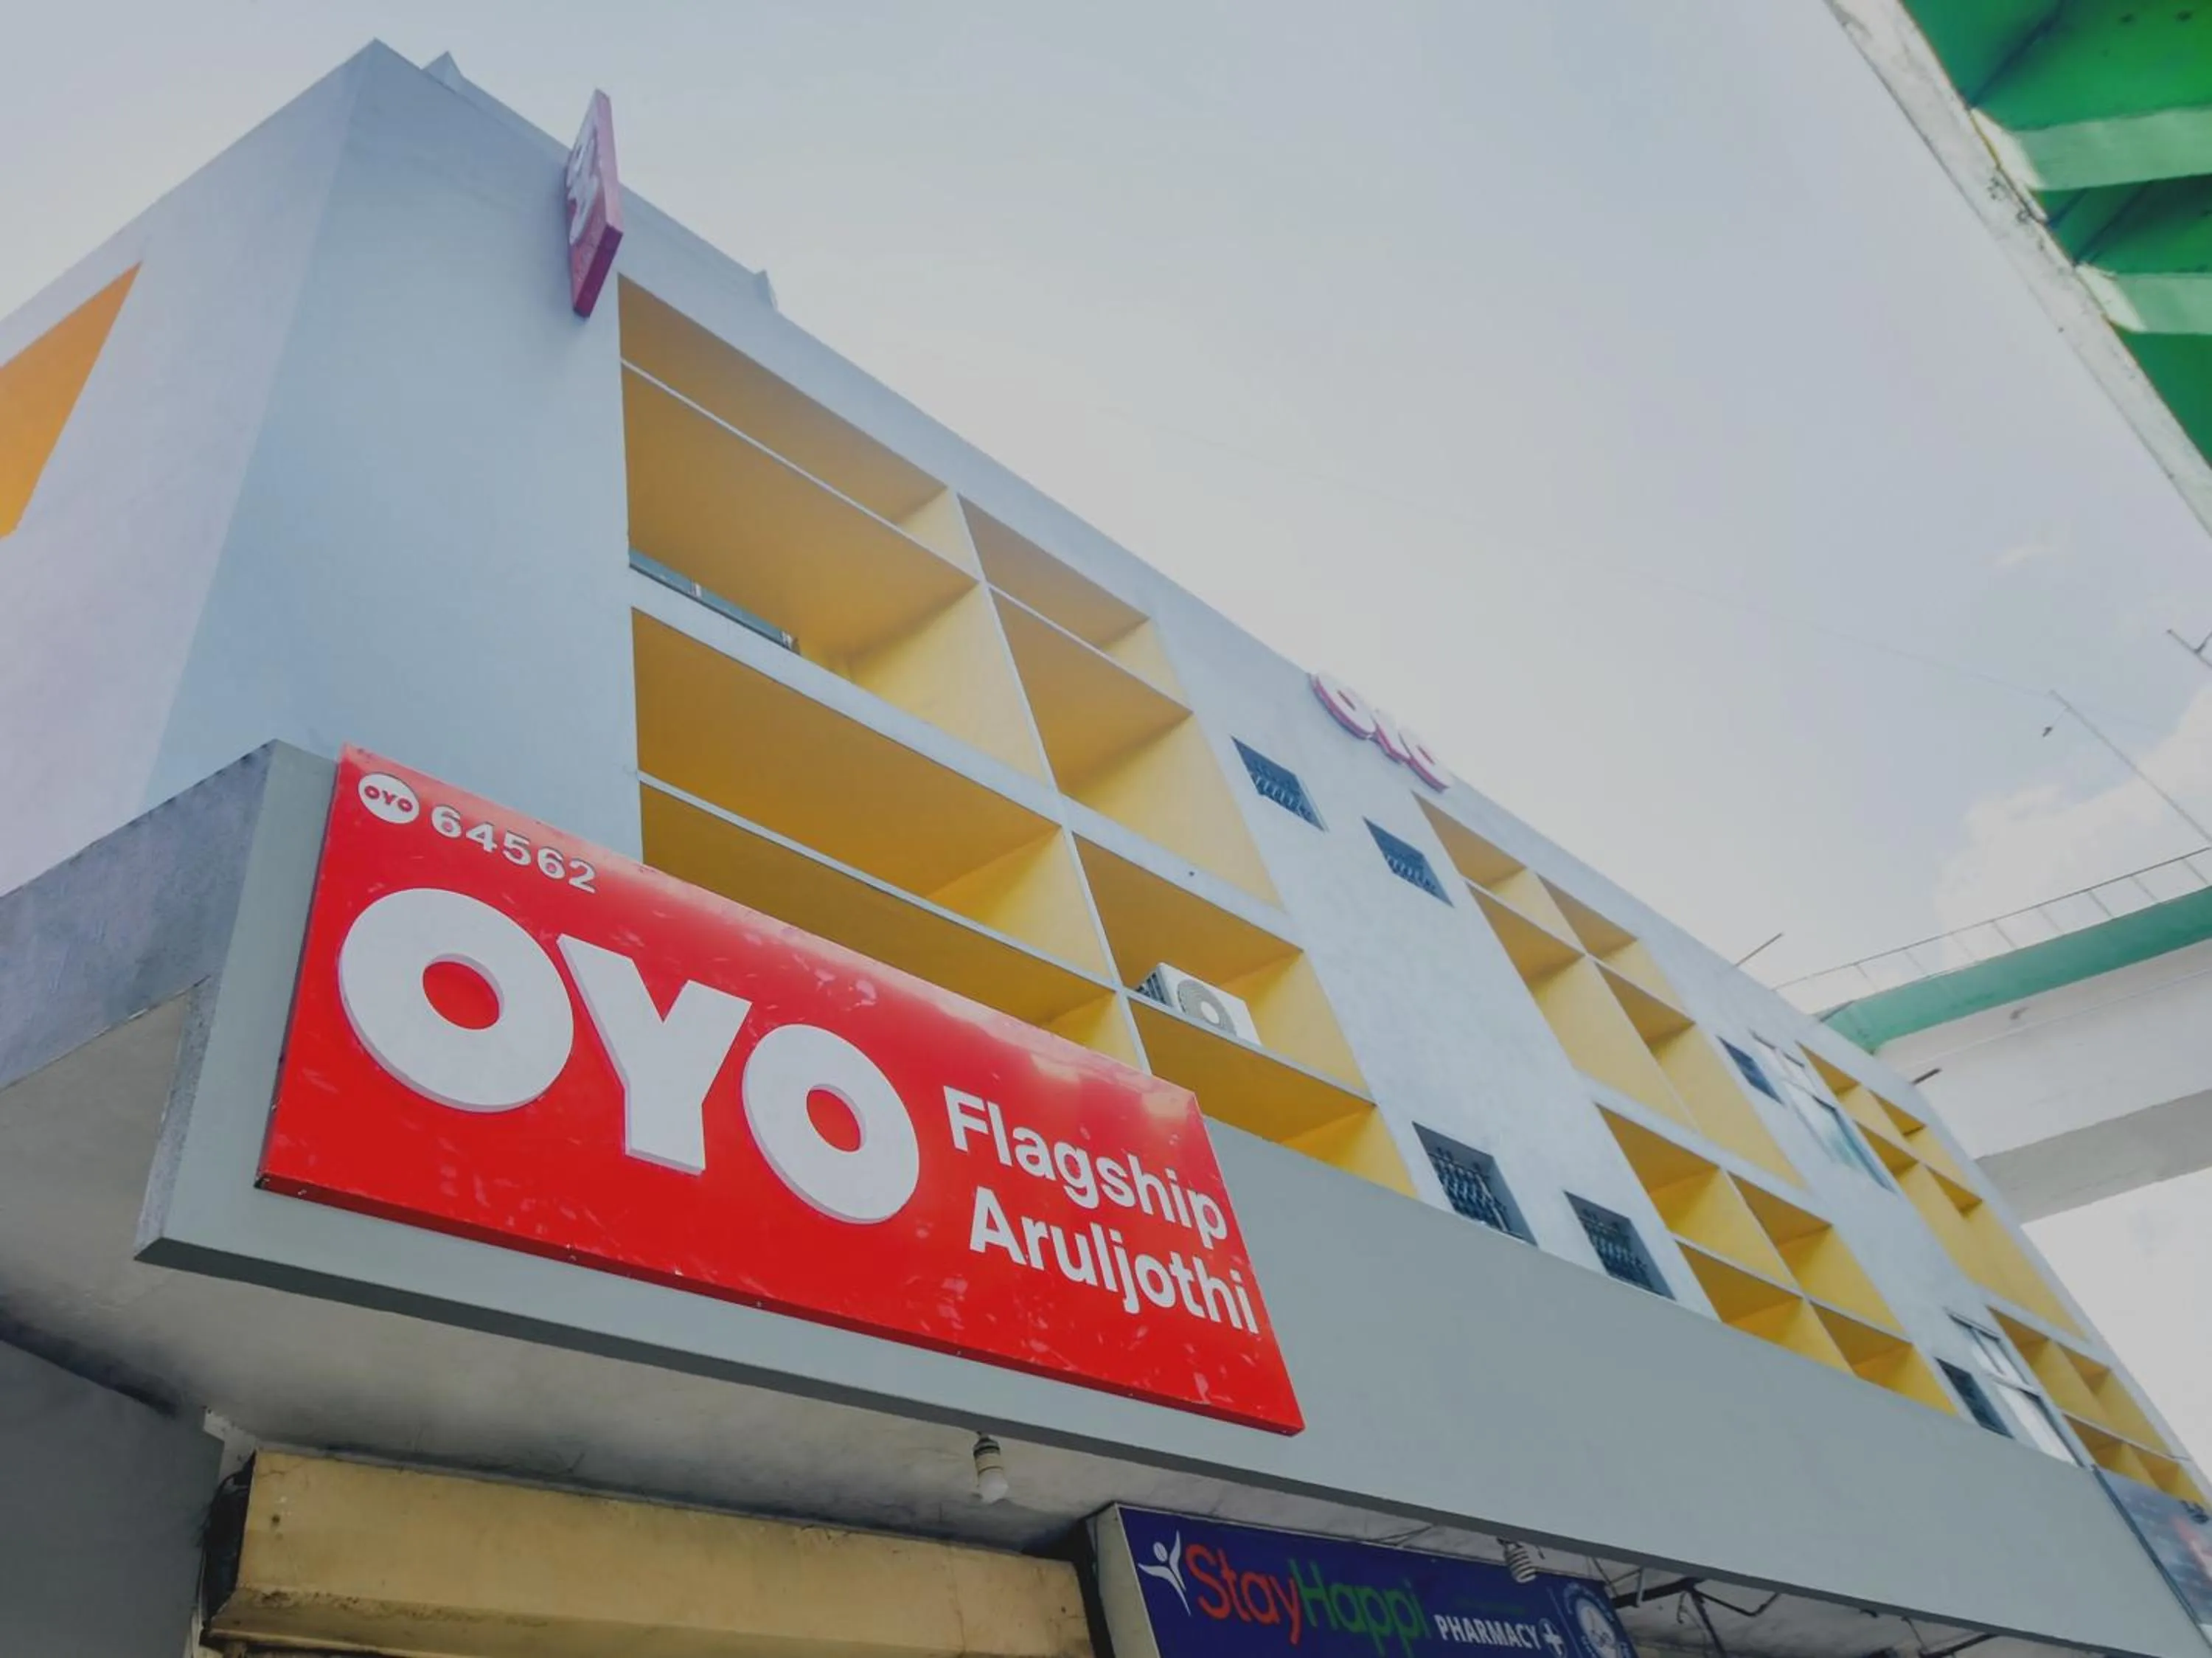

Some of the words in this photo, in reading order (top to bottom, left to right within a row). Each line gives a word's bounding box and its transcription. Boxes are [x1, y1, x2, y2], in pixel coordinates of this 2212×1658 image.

[364, 785, 413, 813] OYO
[431, 804, 597, 894] 64562
[338, 888, 919, 1225] OYO
[943, 1086, 1228, 1249] Flagship
[970, 1186, 1259, 1333] Aruljothi
[1433, 1614, 1543, 1651] PHARMACY
